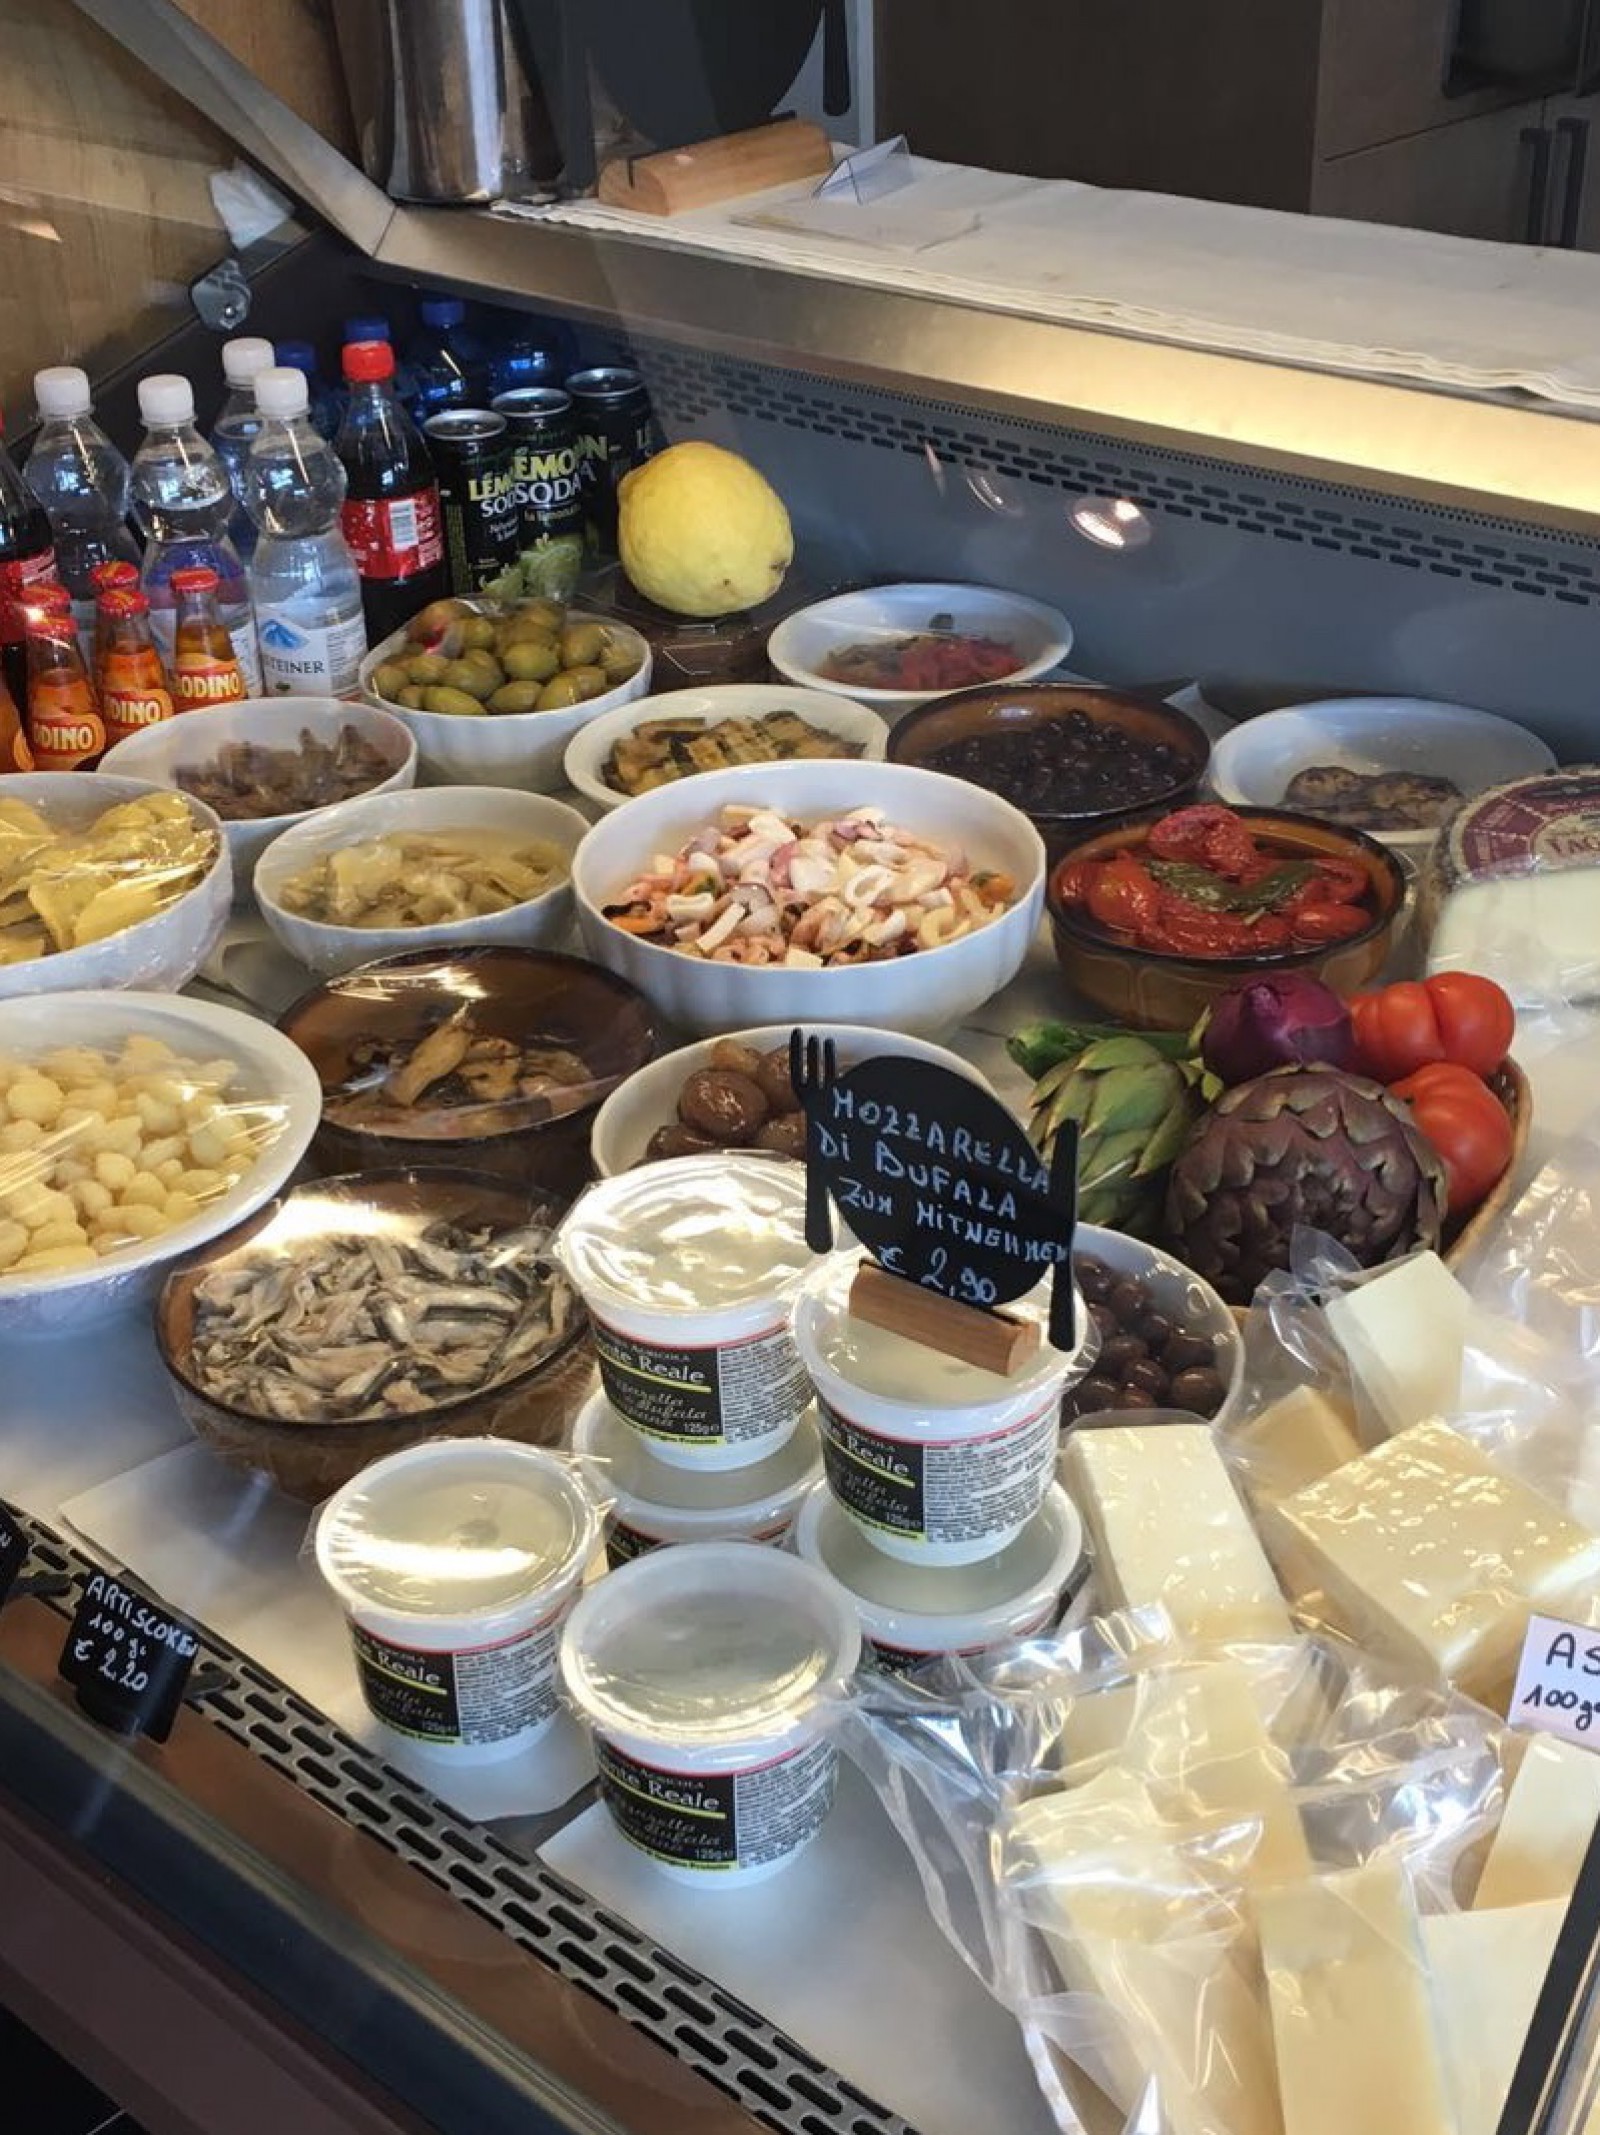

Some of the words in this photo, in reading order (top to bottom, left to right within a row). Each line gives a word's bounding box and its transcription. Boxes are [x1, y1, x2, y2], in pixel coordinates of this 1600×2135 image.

[180, 671, 240, 698] ODINO
[109, 699, 161, 724] DINO
[873, 1139, 1017, 1221] BUFALA
[876, 1244, 907, 1276] €
[638, 1354, 706, 1385] Reale
[846, 1434, 910, 1475] Reale
[88, 1611, 126, 1641] 100
[74, 1637, 95, 1661] €
[1545, 1631, 1600, 1676] AS
[647, 1779, 720, 1811] Reale
